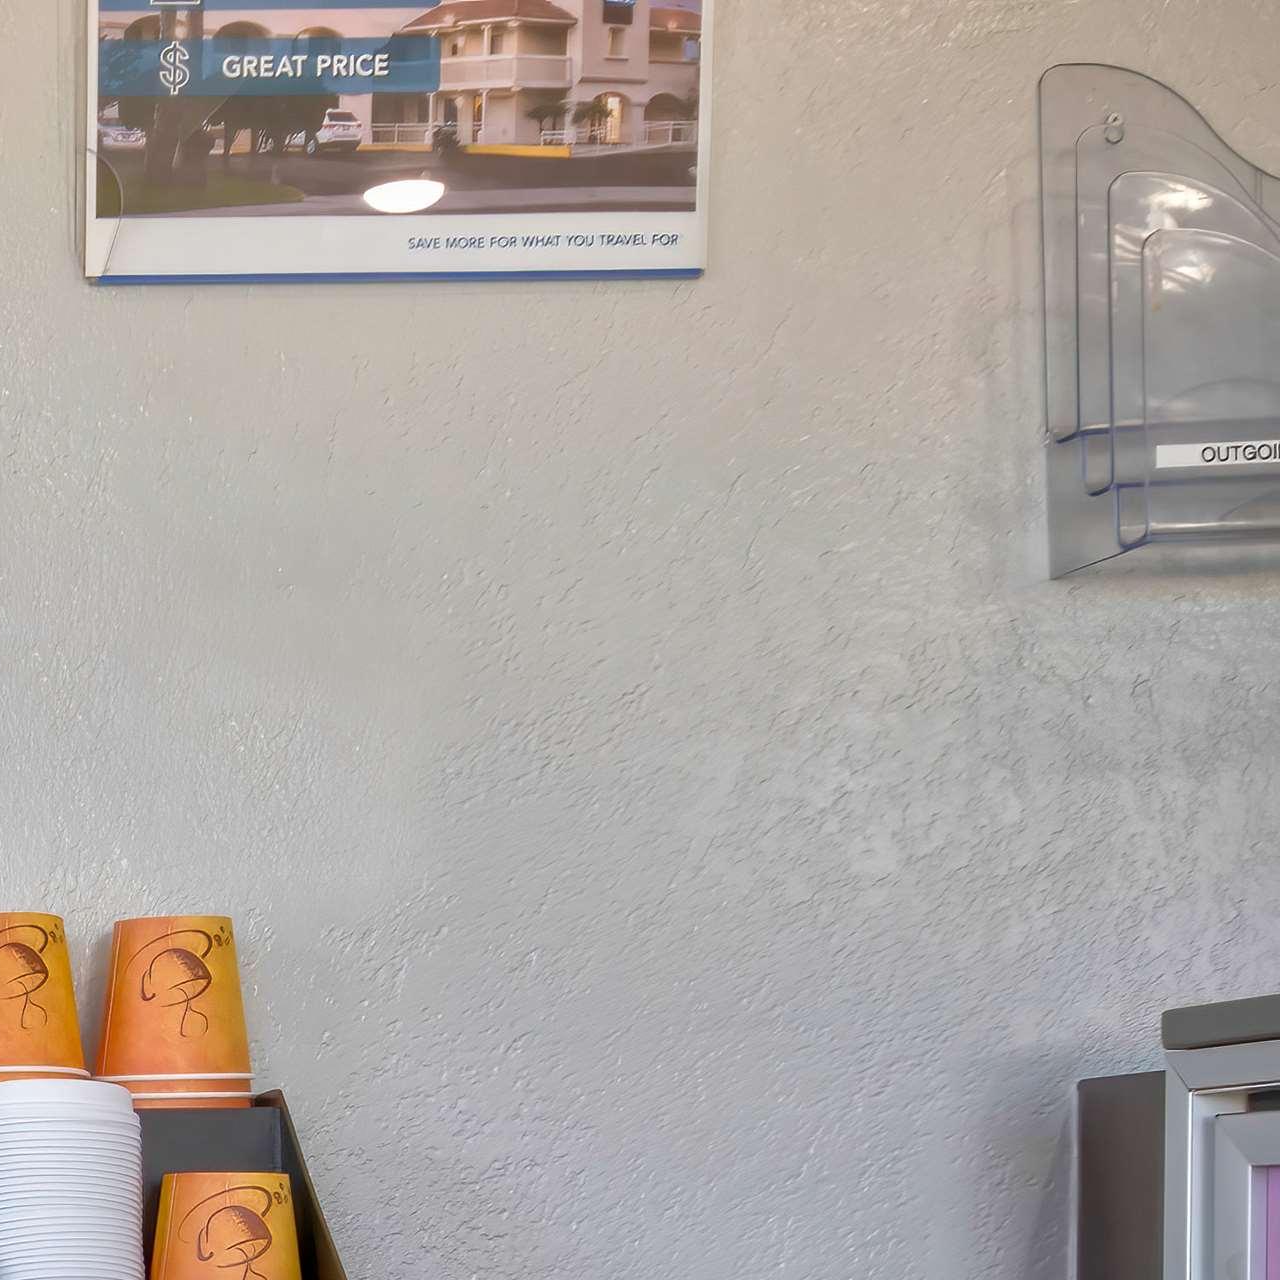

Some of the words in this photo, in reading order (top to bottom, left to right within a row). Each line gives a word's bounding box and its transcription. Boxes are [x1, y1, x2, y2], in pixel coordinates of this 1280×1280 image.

[222, 54, 308, 79] GREAT
[315, 53, 390, 78] PRICE
[407, 236, 441, 249] SAVE
[444, 236, 486, 249] MORE
[489, 236, 518, 248] FOR
[520, 234, 562, 248] WHAT
[566, 234, 595, 247] YOU
[599, 234, 648, 247] TRAVEL
[651, 233, 681, 246] FOR
[1201, 443, 1280, 463] OUTGOI
